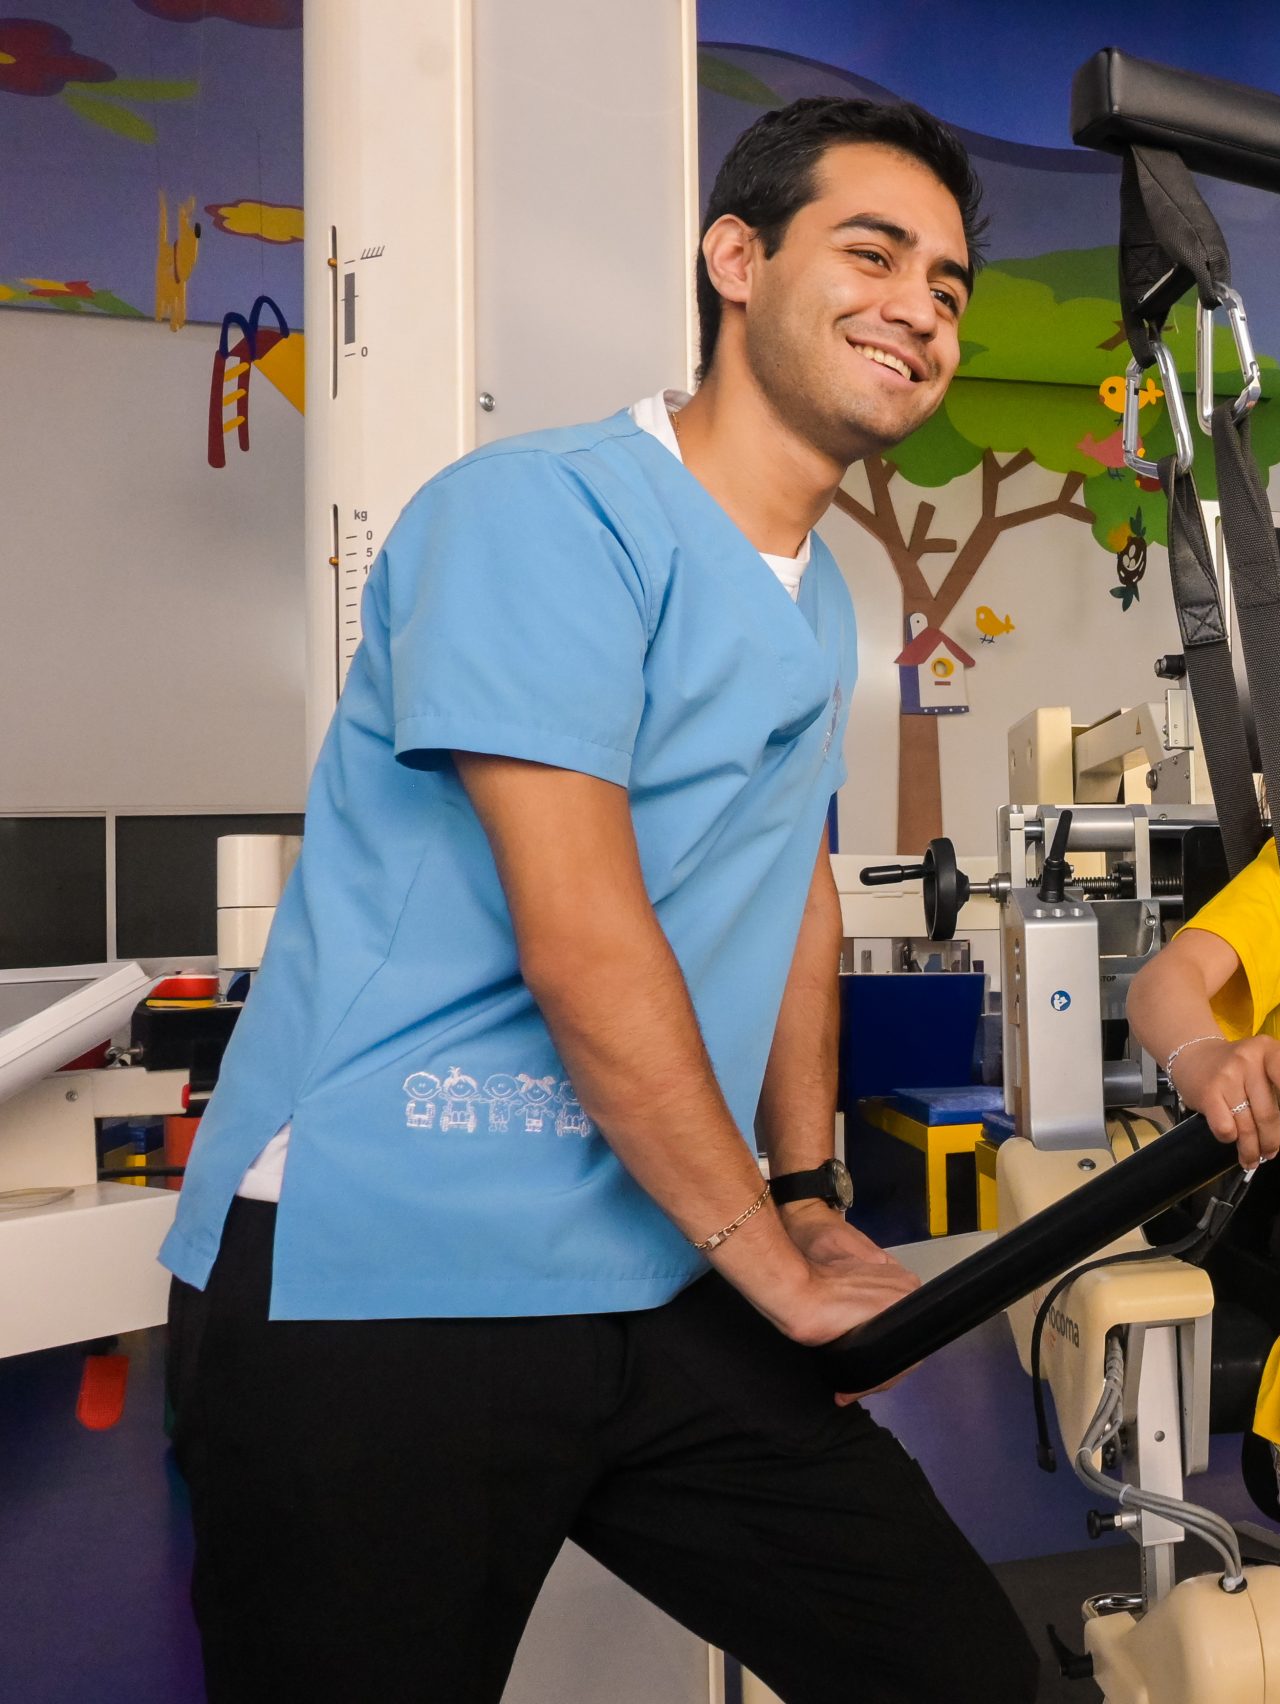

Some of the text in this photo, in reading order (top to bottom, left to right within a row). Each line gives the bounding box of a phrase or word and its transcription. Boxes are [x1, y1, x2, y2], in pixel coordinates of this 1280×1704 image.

[361, 346, 368, 357] 0
[354, 509, 368, 521] kg
[366, 530, 373, 541] 0
[366, 547, 373, 557] 5
